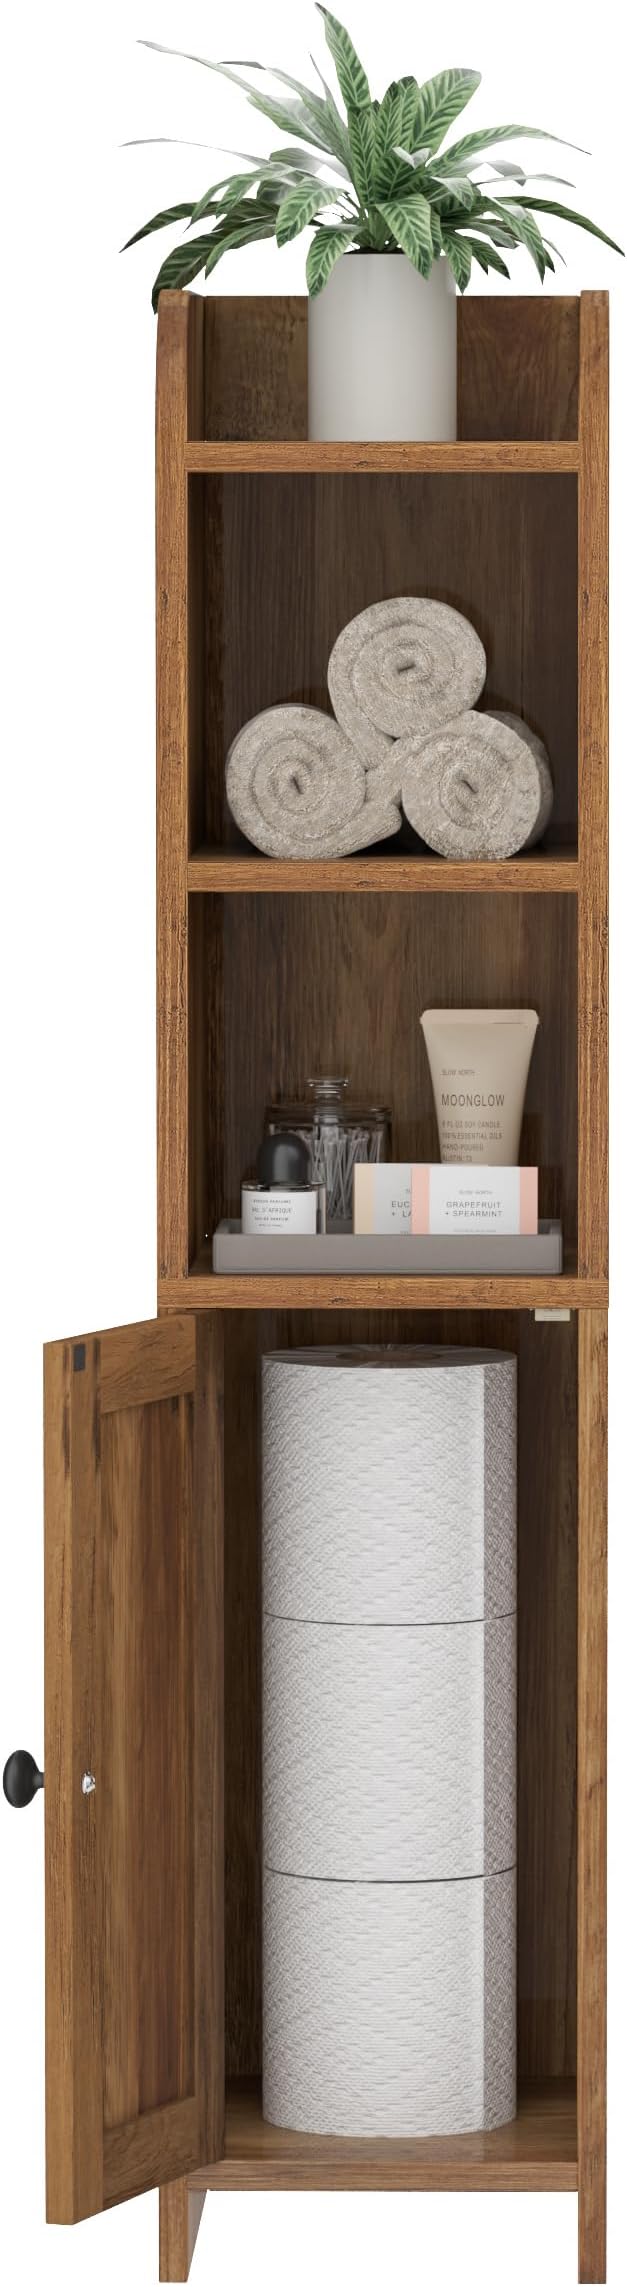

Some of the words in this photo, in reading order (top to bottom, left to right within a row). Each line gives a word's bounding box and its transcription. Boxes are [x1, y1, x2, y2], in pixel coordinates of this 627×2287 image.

[441, 1093, 505, 1107] MOONGLOW
[446, 1201, 502, 1209] GRAPEFRUIT
[452, 1210, 503, 1218] SPEARMINT
